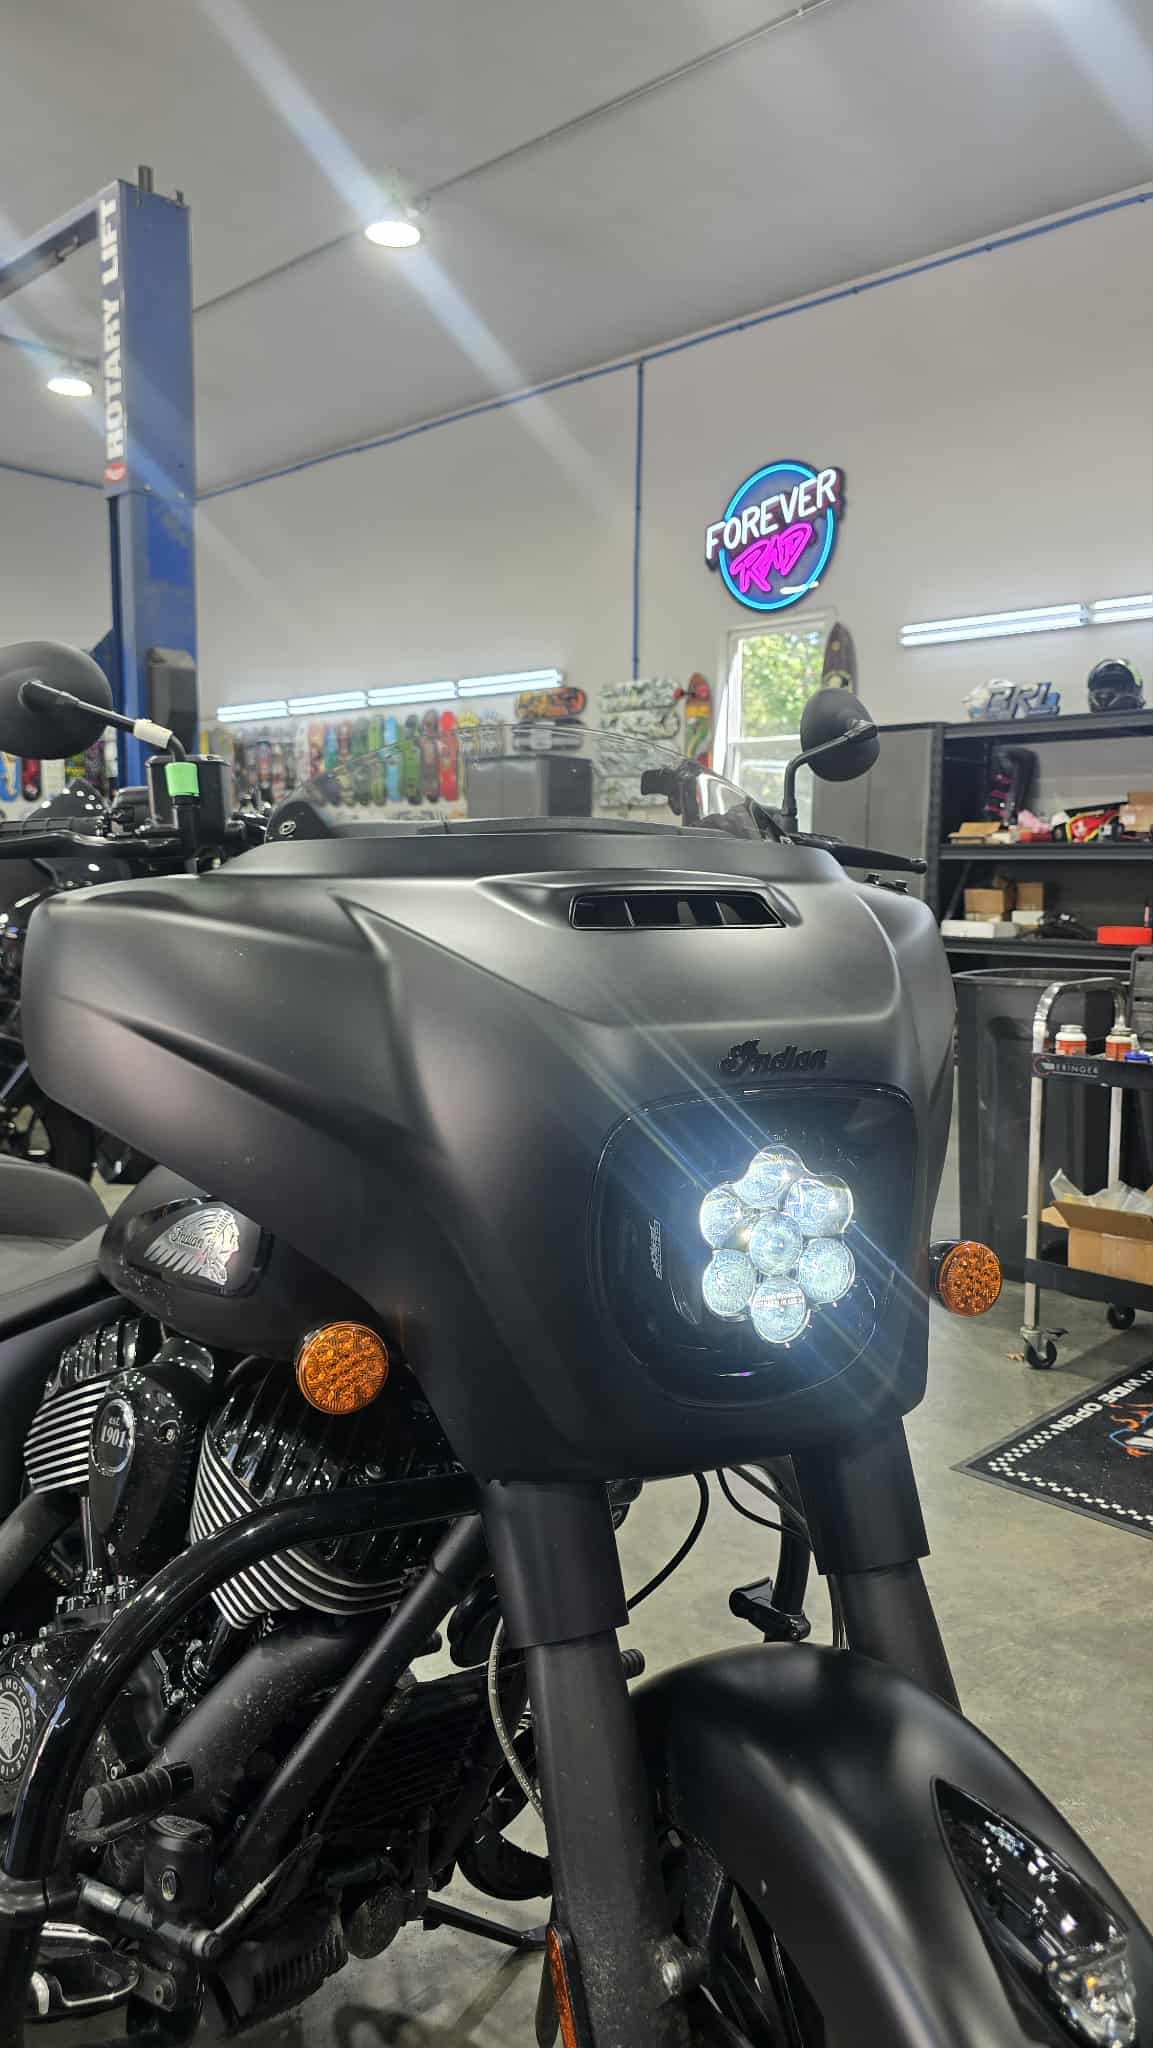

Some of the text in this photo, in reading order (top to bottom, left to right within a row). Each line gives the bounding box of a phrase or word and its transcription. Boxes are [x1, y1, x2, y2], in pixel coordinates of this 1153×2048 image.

[101, 199, 124, 460] ROTARY LIFT
[706, 469, 837, 560] FOREVER
[729, 522, 813, 593] RAD
[719, 1038, 828, 1073] Indian
[170, 1224, 203, 1249] Indian
[1049, 1378, 1148, 1431] WIDE OPEN
[101, 1424, 127, 1448] 1901
